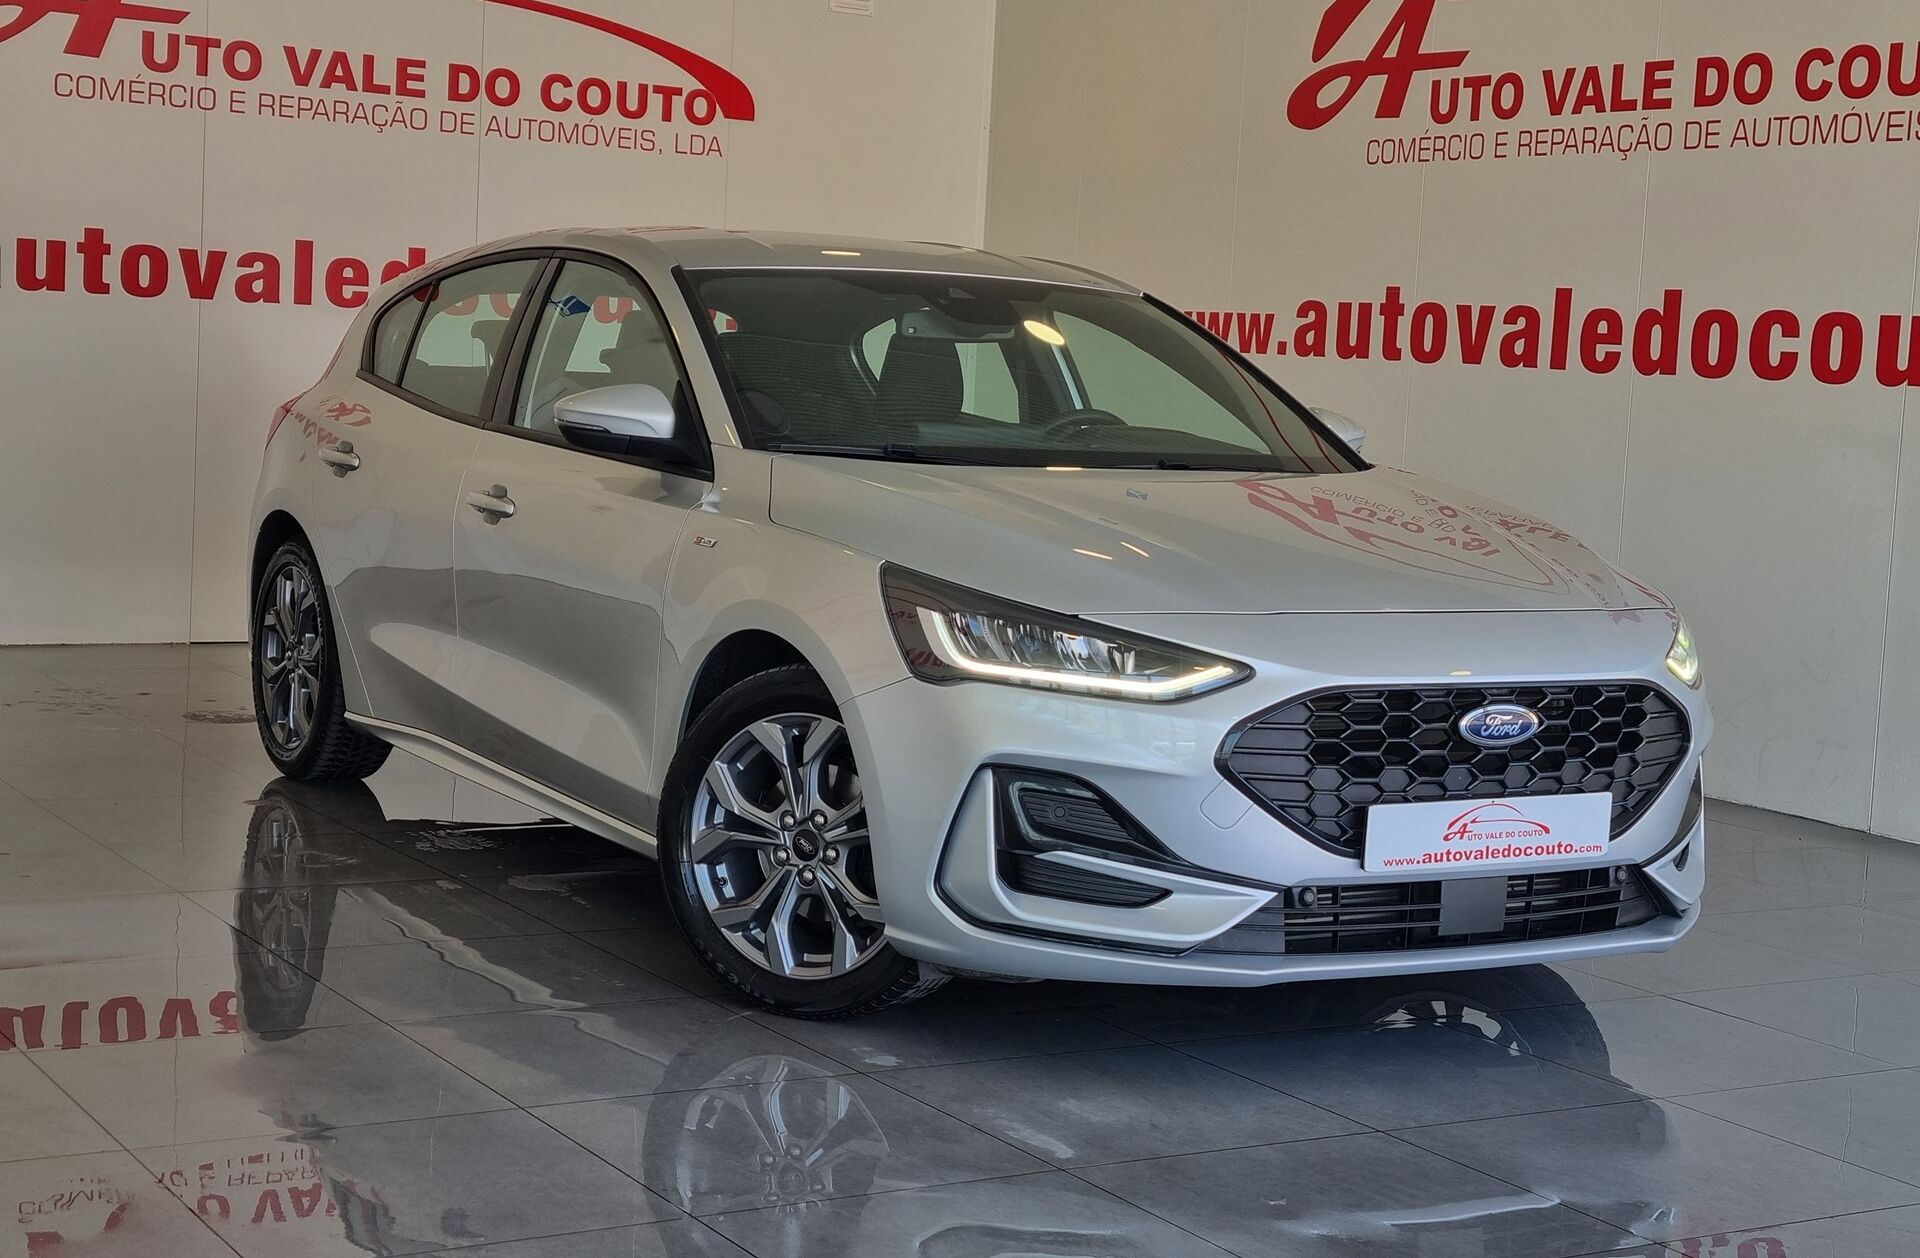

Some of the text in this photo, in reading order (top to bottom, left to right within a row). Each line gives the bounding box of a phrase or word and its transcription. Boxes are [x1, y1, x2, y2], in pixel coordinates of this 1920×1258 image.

[283, 44, 428, 101] VALE
[447, 62, 521, 107] DO
[539, 72, 718, 126] COUTO
[1286, 0, 1525, 130] AUTO
[1542, 59, 1676, 116] VALE
[1693, 52, 1774, 108] DO
[54, 72, 723, 157] COMÉRCIO E REPARAÇÃO DE AUTOMÓVEIS, LDA
[1366, 106, 1920, 165] COMÉRCIO E REPARAÇÃO DE AUTOMÓVEI
[1481, 714, 1522, 737] Ford
[1383, 841, 1602, 866] www.autovaledocouto.com
[1443, 823, 1543, 841] AUTO VALE DO COUTO
